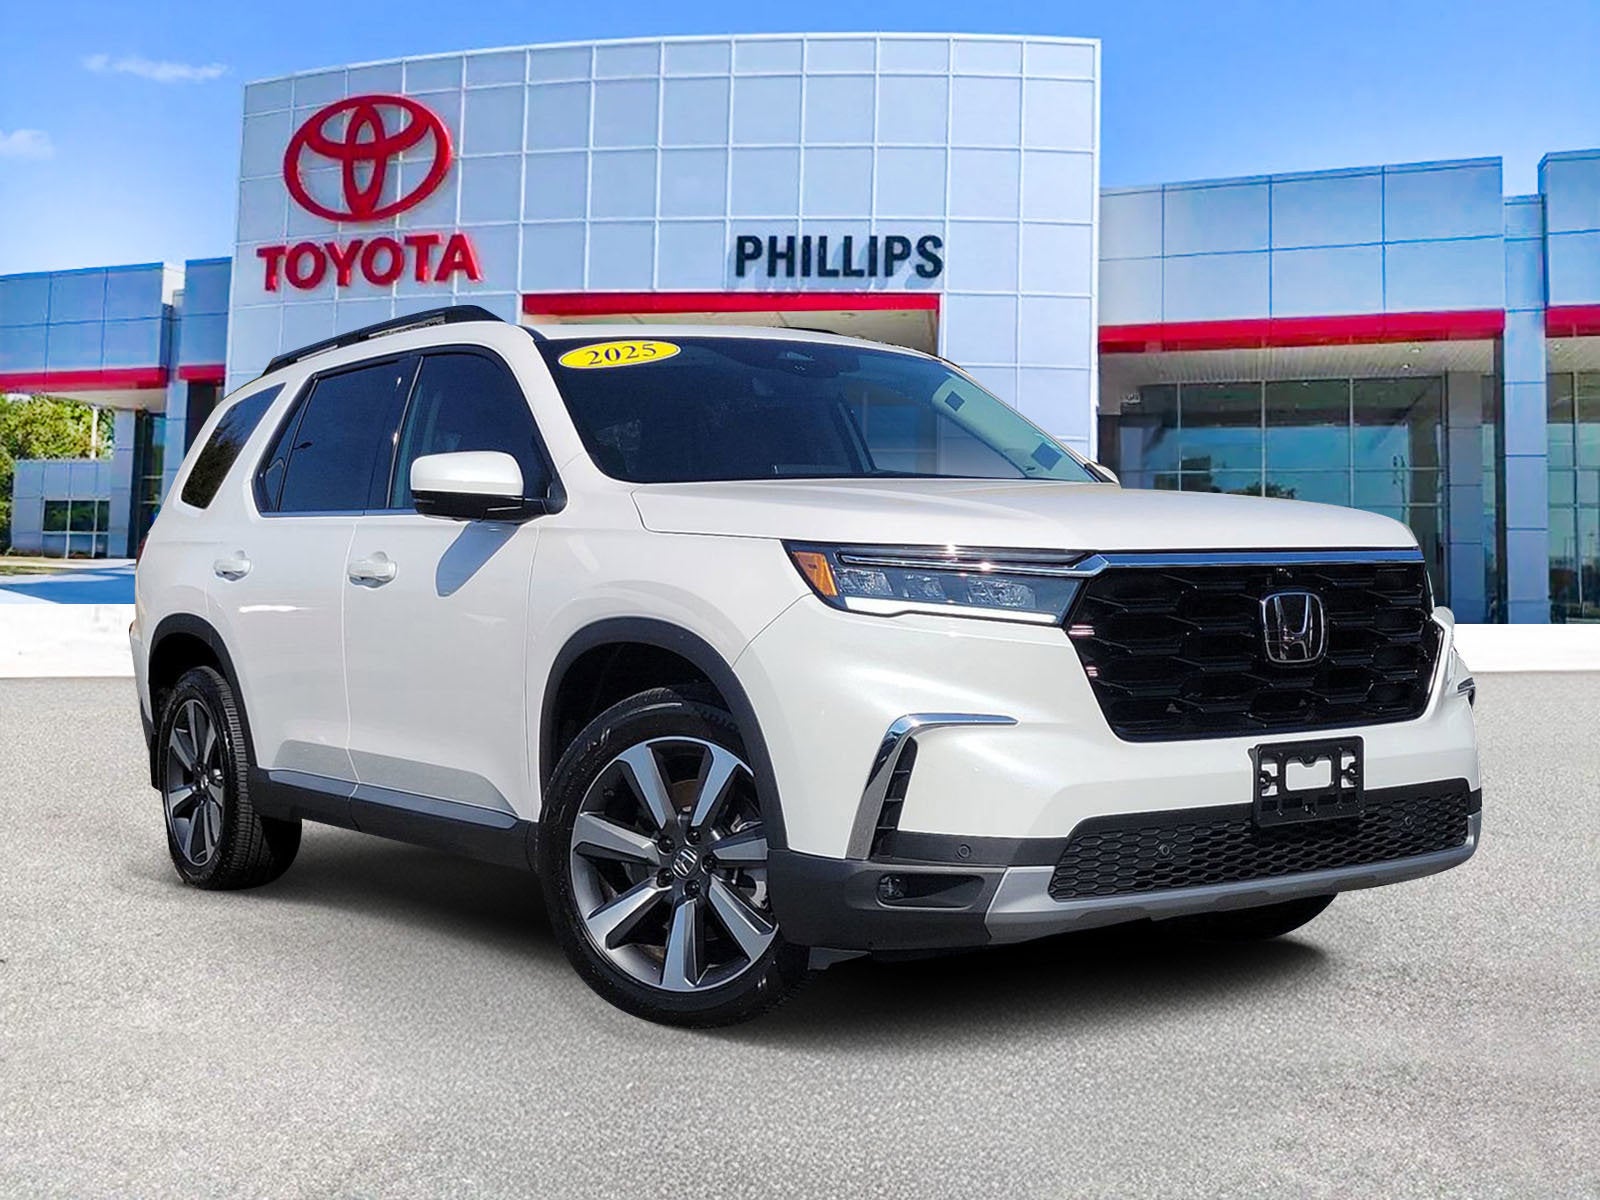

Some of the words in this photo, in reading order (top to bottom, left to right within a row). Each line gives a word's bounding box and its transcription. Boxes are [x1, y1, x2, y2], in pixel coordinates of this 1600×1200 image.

[256, 233, 483, 292] TOYOTA
[735, 235, 944, 278] PHILLIPS
[585, 343, 657, 365] 2025
